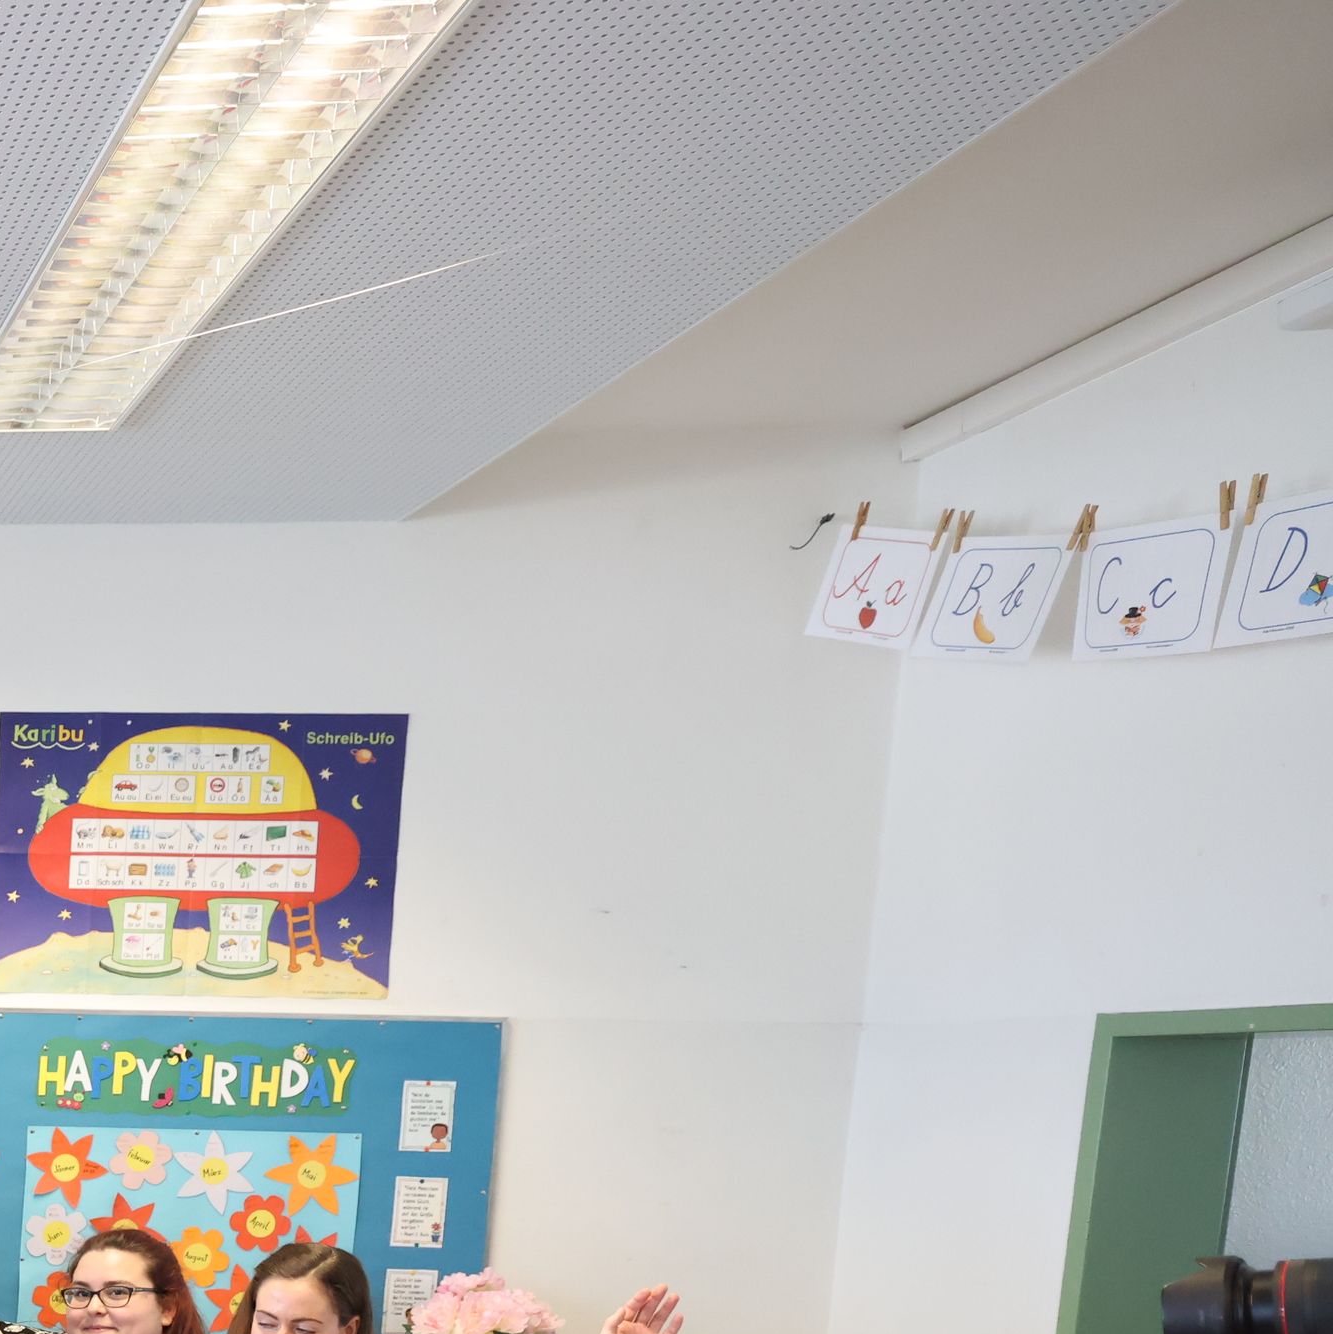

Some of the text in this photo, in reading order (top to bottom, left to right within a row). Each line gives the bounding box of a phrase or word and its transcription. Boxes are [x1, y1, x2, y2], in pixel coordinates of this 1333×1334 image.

[1259, 526, 1309, 594] D
[832, 553, 908, 606] A a
[1096, 556, 1177, 615] C c
[952, 561, 1036, 618] B b
[13, 724, 84, 743] Karibu
[306, 731, 395, 745] Schreib-Ufo
[37, 1049, 356, 1109] HAPPY BIRTHDAY
[127, 1148, 151, 1166] Februar
[202, 1168, 222, 1178] März
[302, 1167, 317, 1182] Mai
[249, 1215, 271, 1231] April
[47, 1227, 64, 1243] Juni
[184, 1250, 209, 1264] August
